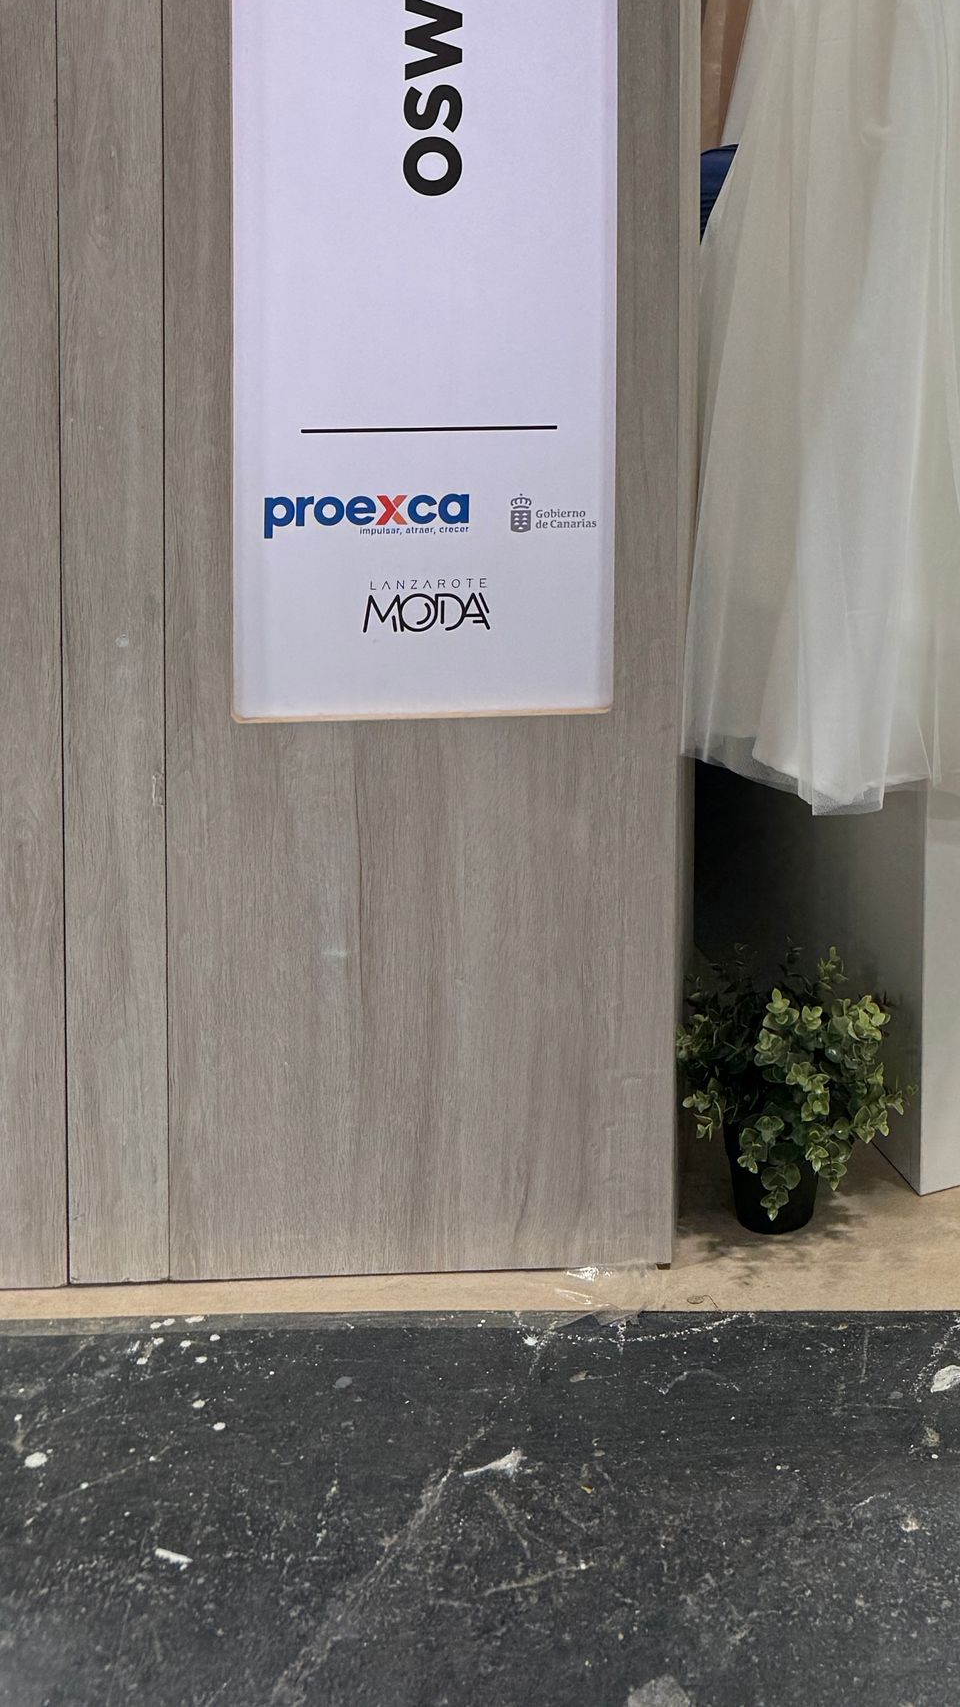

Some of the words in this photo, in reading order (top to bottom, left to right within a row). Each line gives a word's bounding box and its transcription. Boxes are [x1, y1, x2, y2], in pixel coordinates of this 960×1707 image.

[264, 494, 470, 539] proexca
[535, 509, 586, 519] Gobierno
[535, 520, 549, 529] de
[550, 519, 597, 529] Canarias
[370, 578, 487, 591] LANZAROTE
[362, 592, 491, 633] MODA
